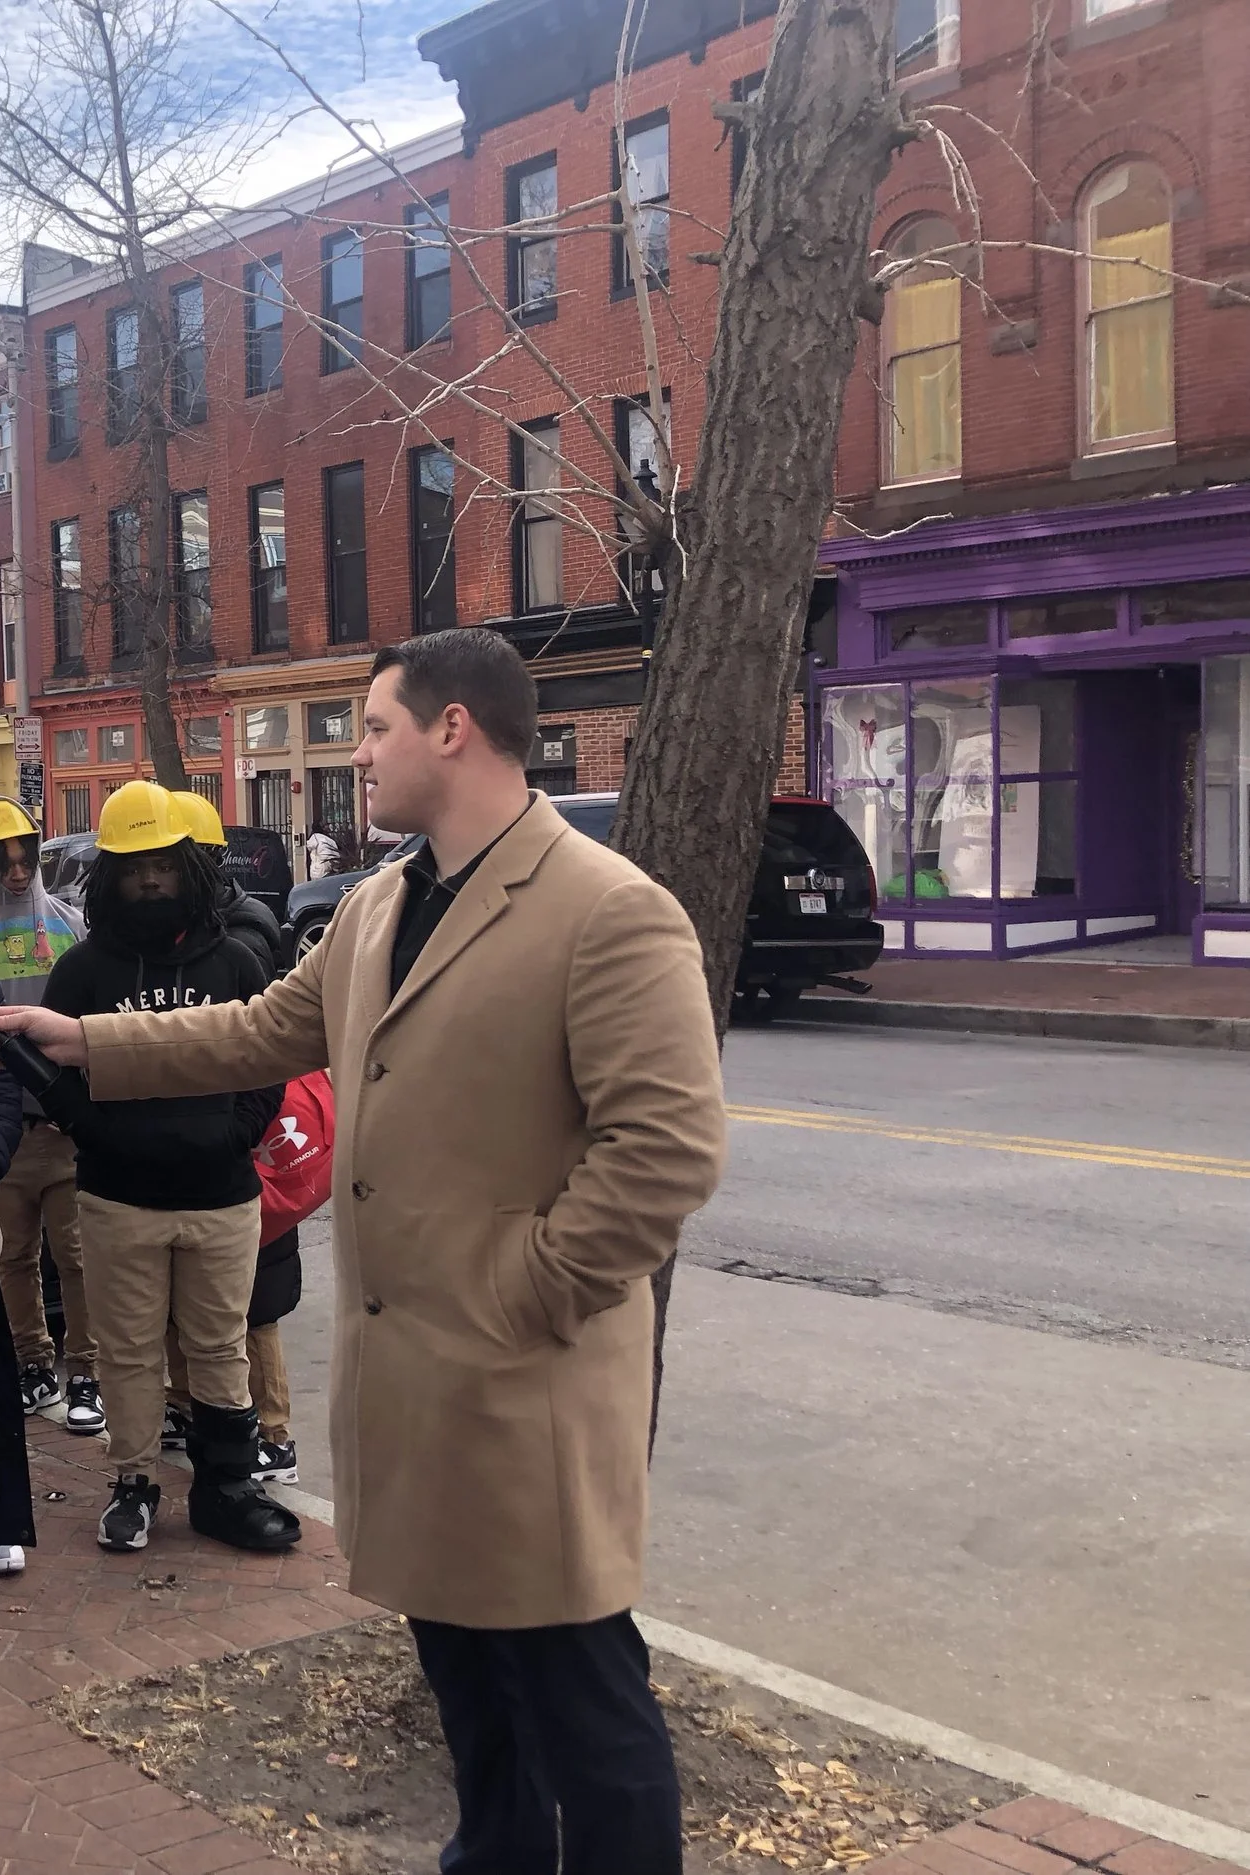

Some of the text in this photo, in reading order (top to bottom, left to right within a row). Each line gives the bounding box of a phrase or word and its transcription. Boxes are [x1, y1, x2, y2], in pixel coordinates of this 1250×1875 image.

[15, 719, 24, 728] NO
[237, 760, 254, 772] FDC
[21, 773, 42, 782] PARKING
[289, 1146, 320, 1169] ARMOUR
